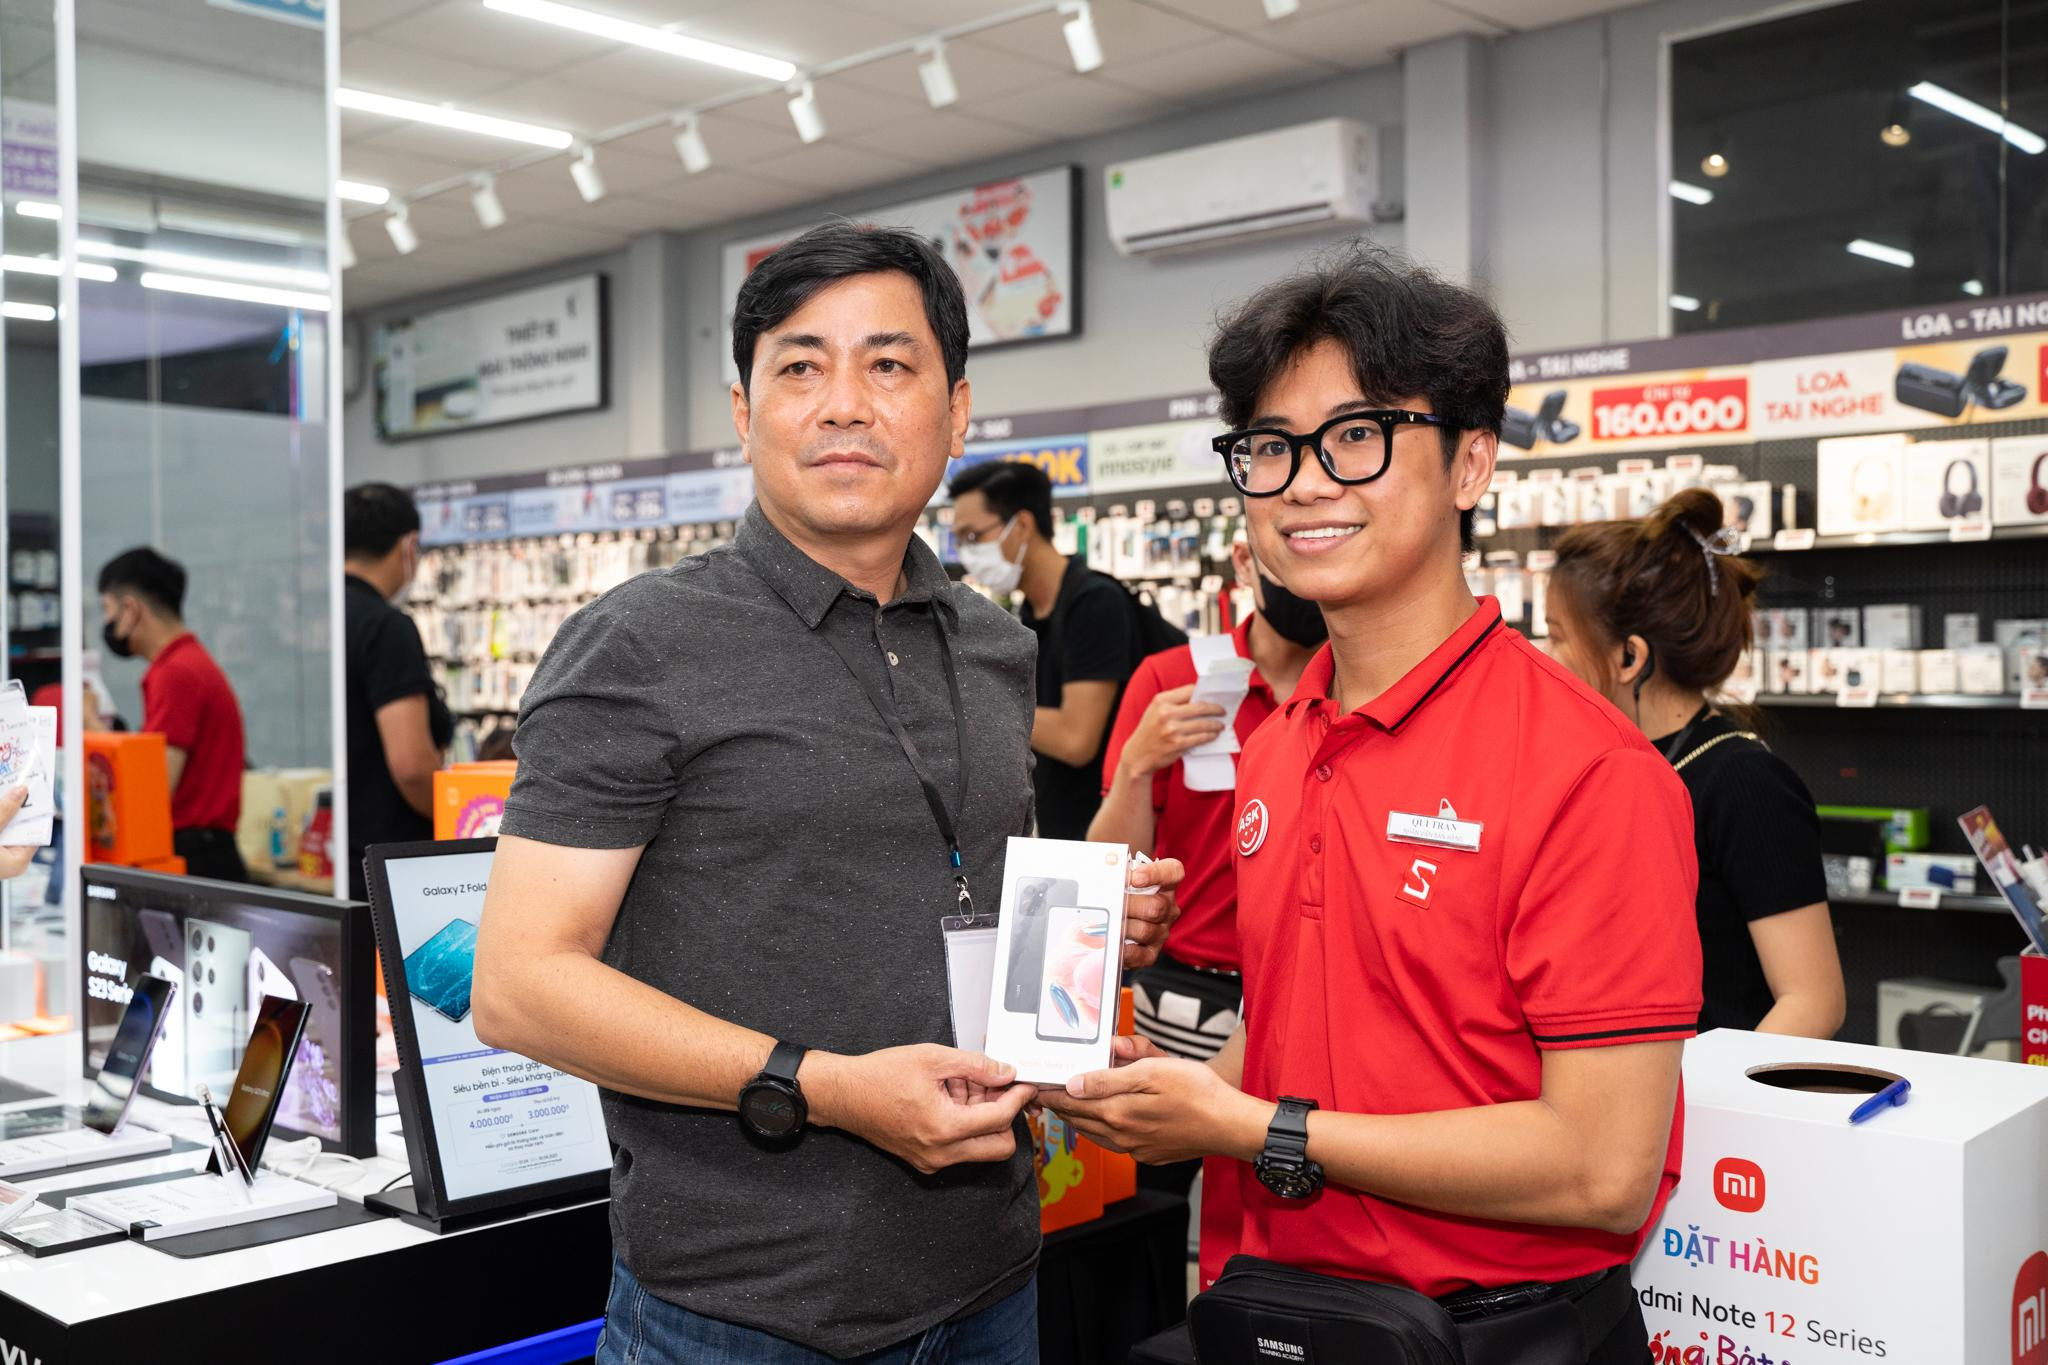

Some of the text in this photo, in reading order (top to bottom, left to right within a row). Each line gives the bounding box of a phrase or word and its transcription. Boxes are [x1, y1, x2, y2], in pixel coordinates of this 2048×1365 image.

[1902, 311, 1952, 340] LOA
[1969, 306, 2010, 331] TAI
[2016, 299, 2048, 326] NG
[1571, 347, 1631, 376] NGHE
[1796, 370, 1848, 394] LOA
[1595, 396, 1745, 437] 160.000
[1766, 393, 1884, 421] TAI NGHE
[1238, 807, 1259, 832] ASK
[423, 882, 487, 897] Galaxy Z Fold
[87, 950, 127, 983] Galaxy
[88, 976, 134, 1005] S23 Serie
[453, 1084, 471, 1094] Siêu
[506, 1076, 524, 1086] Siêu
[525, 1070, 552, 1081] kháng
[482, 1065, 500, 1077] Điện
[502, 1062, 524, 1074] thoại
[1663, 1224, 1819, 1285] ĐẶT HÀNG
[1631, 1286, 1887, 1358] dmi Note 12 Series
[1257, 1337, 1304, 1356] SAMSUNG
[1259, 1347, 1282, 1358] TRAINING
[1649, 1330, 1709, 1365] ống
